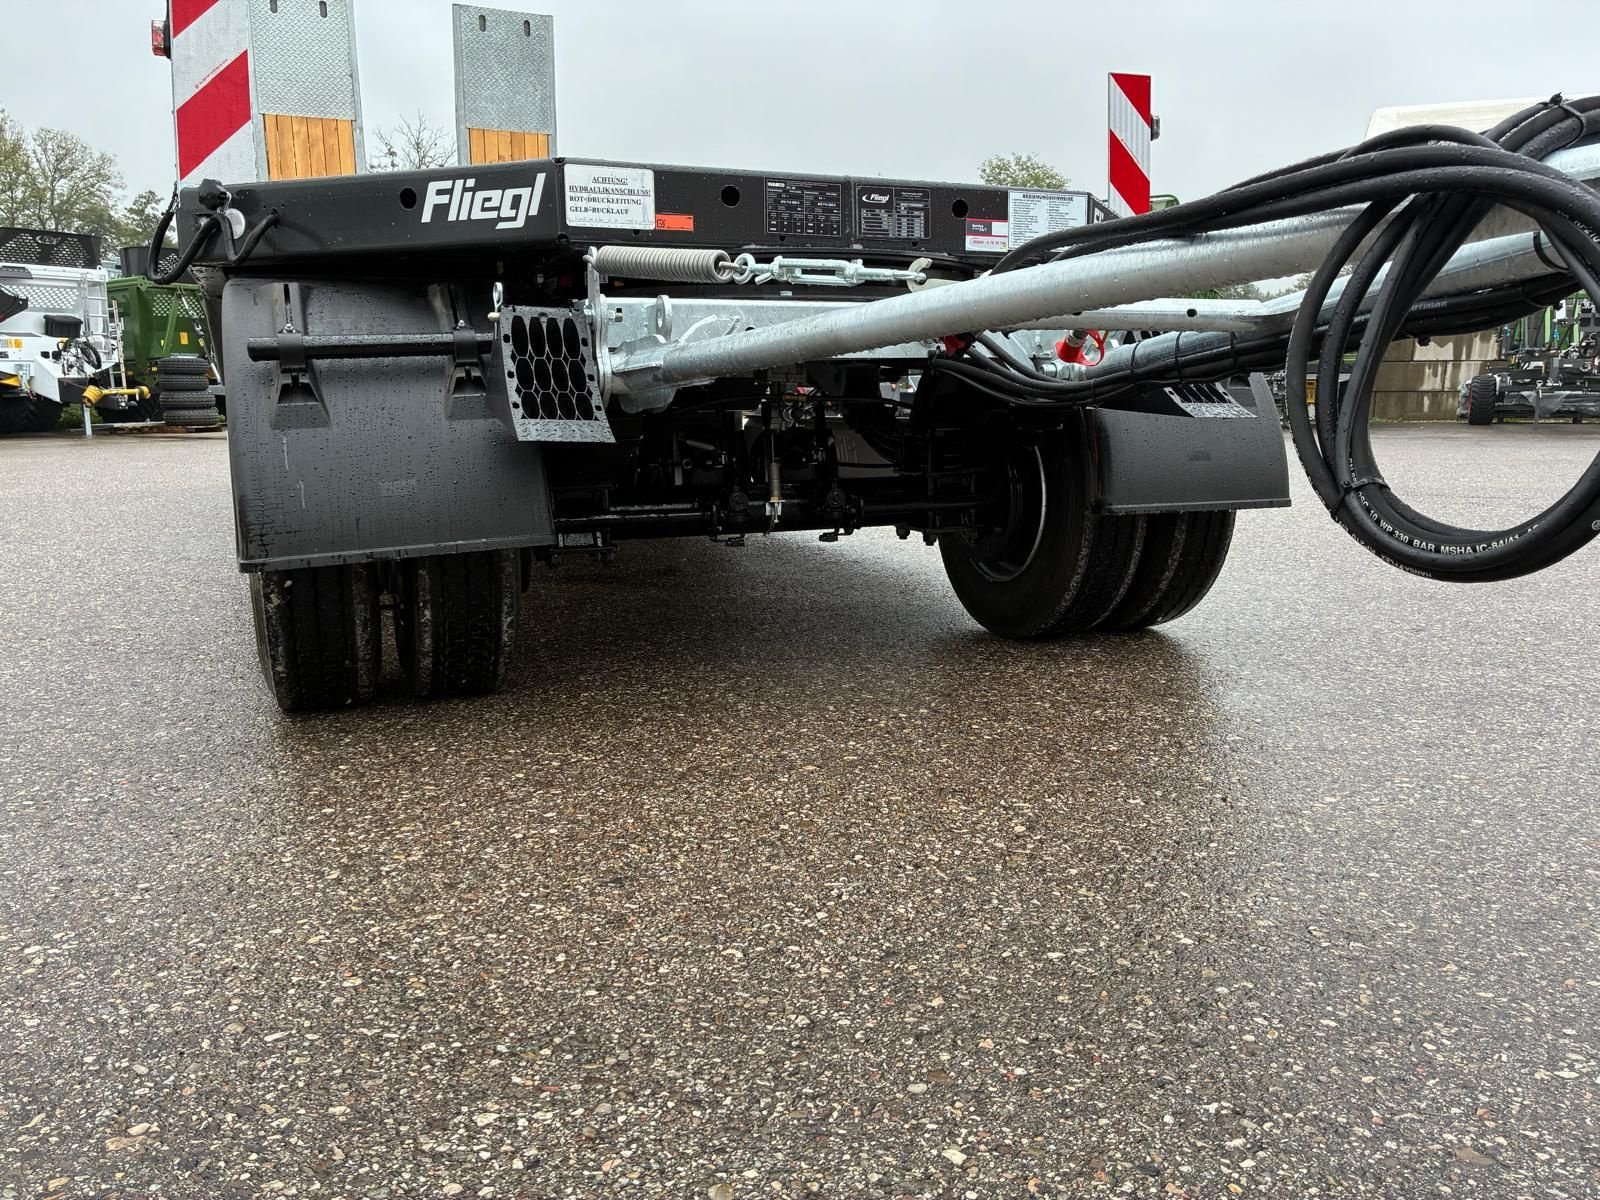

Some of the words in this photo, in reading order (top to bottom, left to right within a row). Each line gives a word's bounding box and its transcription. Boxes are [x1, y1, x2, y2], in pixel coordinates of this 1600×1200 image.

[421, 173, 546, 229] Fliegl
[592, 176, 628, 185] ACHTUNG!
[1369, 510, 1379, 521] 10
[1380, 519, 1393, 533] WP
[1393, 530, 1409, 544] 330
[1413, 539, 1436, 552] BAR
[1440, 545, 1474, 555] MSHA
